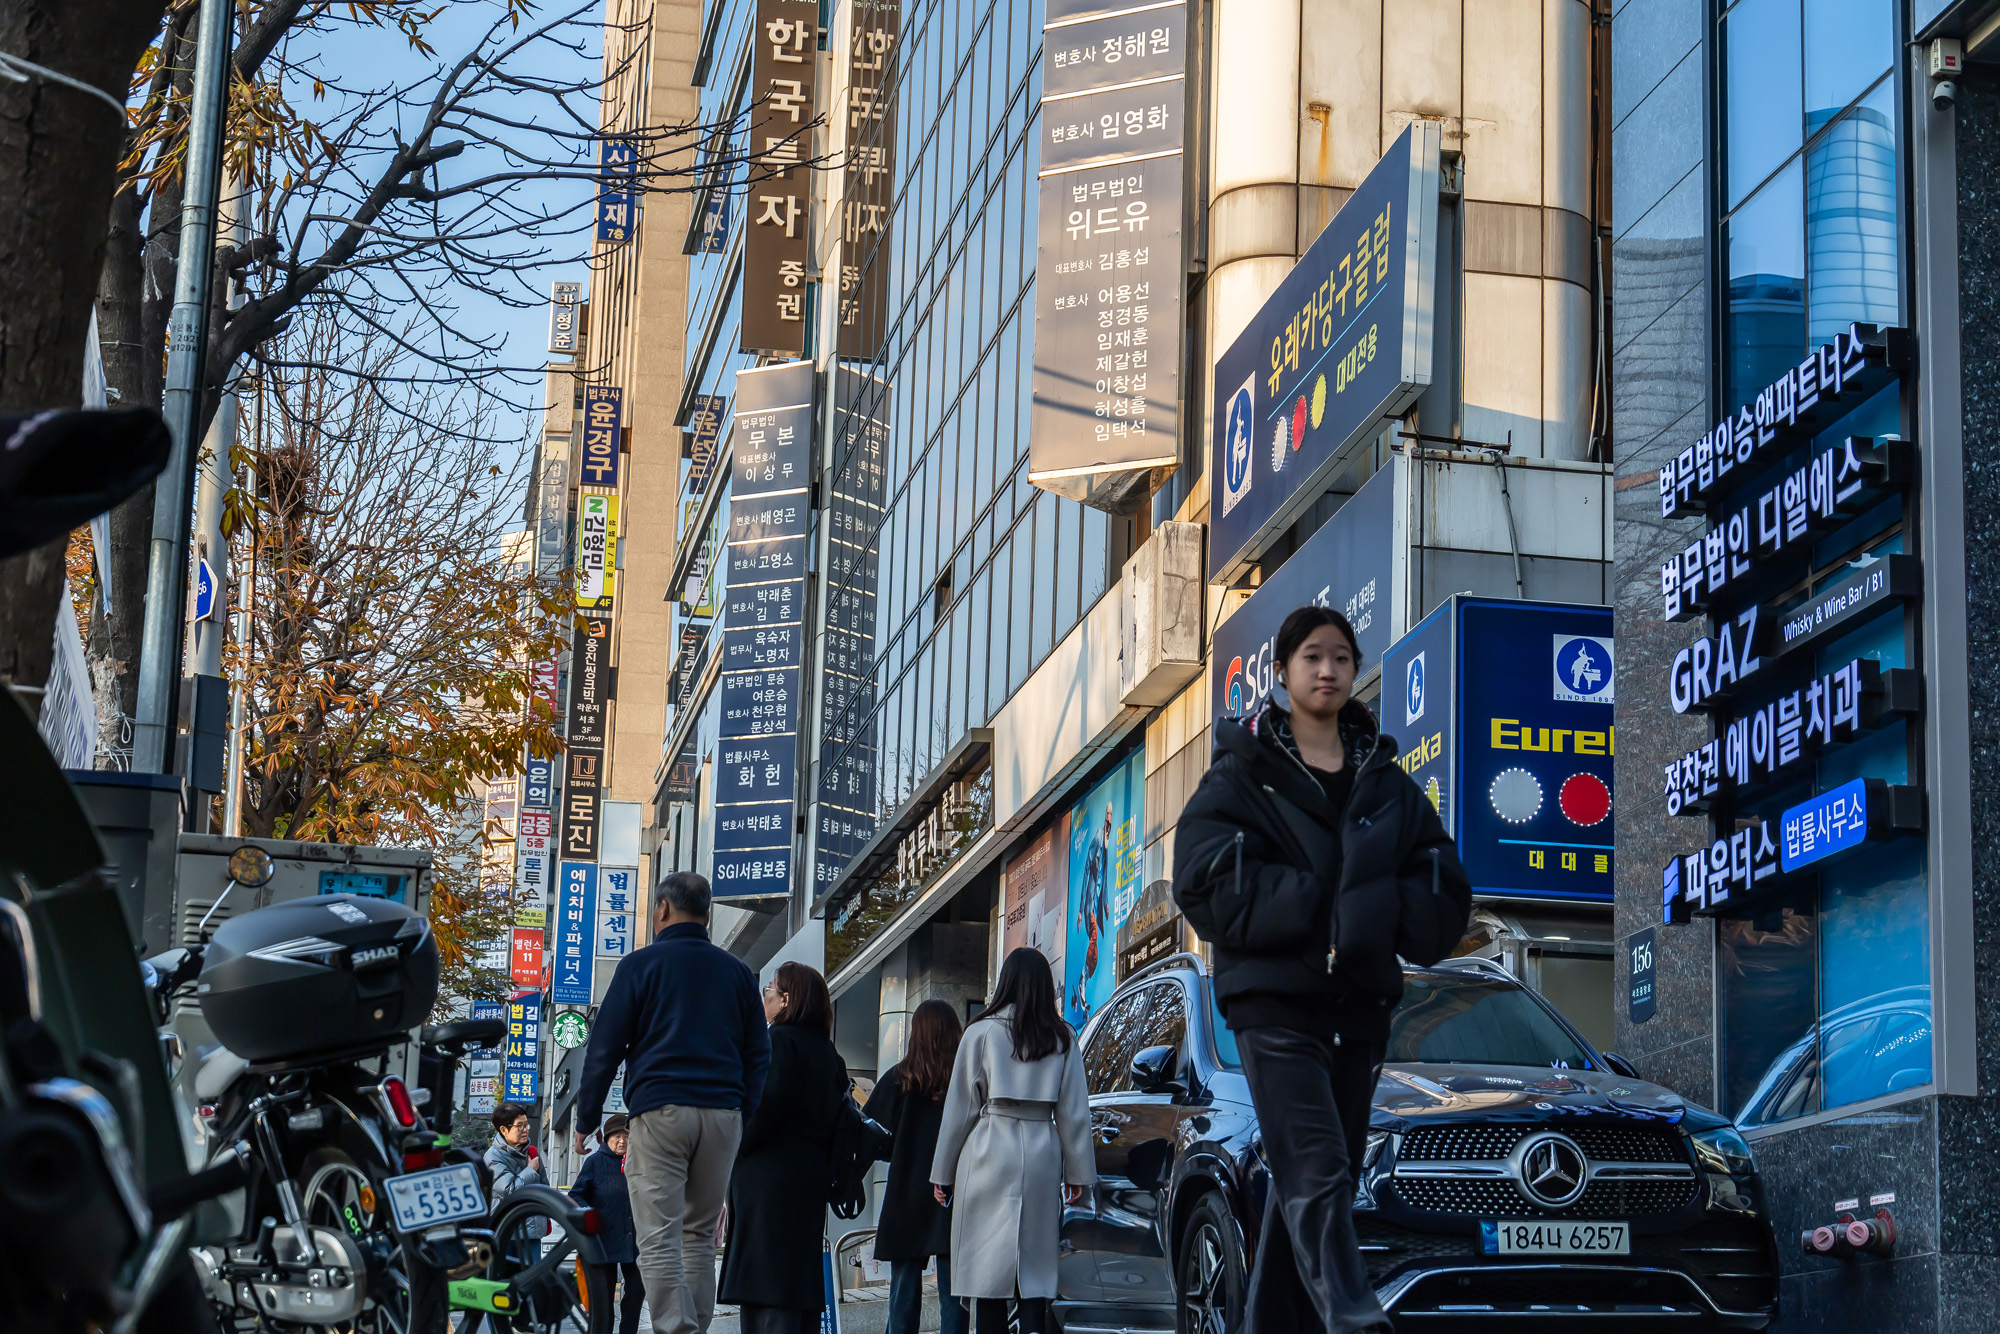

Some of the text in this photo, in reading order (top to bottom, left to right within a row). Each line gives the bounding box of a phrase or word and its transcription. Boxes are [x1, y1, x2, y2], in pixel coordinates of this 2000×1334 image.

[1054, 27, 1170, 69] 변호사 정해원
[756, 18, 809, 239] 한국투자
[1051, 104, 1169, 144] 변호사 임영화
[1073, 175, 1143, 203] 법무법인
[1066, 201, 1150, 241] 위드유
[607, 228, 625, 240] 7층
[1055, 247, 1149, 274] 대표변호사 김홍섭
[776, 261, 805, 322] 증권
[1054, 281, 1150, 310] 변호사 어용선
[1268, 201, 1391, 398] 유레카당구클럽
[1098, 304, 1149, 328] 정경동
[1097, 327, 1149, 351] 임재훈
[1095, 350, 1148, 372] 제갈헌
[1336, 323, 1377, 394] 대대전용
[1095, 372, 1147, 394] 이창섭
[588, 388, 620, 402] 법무사
[1095, 395, 1147, 417] 허성흠
[741, 415, 776, 429] 법무법인
[1095, 418, 1146, 442] 임택석
[586, 402, 617, 482] 윤경구
[748, 426, 795, 449] 무본
[739, 451, 776, 465] 대표변호사
[745, 463, 794, 482] 이상무
[736, 507, 796, 526] 변호사 배영곤
[1662, 435, 1862, 622] 법무법인 디엘에스
[734, 552, 793, 570] 변호사 고영소
[599, 598, 611, 608] 4F
[757, 587, 792, 604] 박래춘
[1784, 613, 1814, 642] Whisky
[1815, 606, 1823, 625] &
[1824, 596, 1846, 619] Wine
[1848, 585, 1863, 606] Bar
[1872, 569, 1883, 592] B1
[732, 602, 791, 622] 변호사 김준
[730, 644, 790, 663] 법무사 노명자
[1670, 605, 1760, 714] GRAZ
[583, 638, 598, 704] 웅진씽크빅
[727, 673, 785, 689] 법무법인 문승
[752, 688, 788, 703] 여운승
[1556, 693, 1587, 702] SINDS
[577, 703, 600, 713] 라운지
[727, 703, 787, 719] 변호사 천우현
[579, 715, 595, 724] 서초
[581, 726, 592, 734] 3F
[750, 718, 787, 734] 문상석
[725, 749, 770, 764] 법률사무소
[570, 780, 597, 788] 법률사무소
[738, 763, 781, 789] 화헌
[1664, 738, 1719, 817] 정찬권
[522, 815, 551, 836] 공증
[568, 795, 593, 853] 로진
[722, 815, 782, 832] 변호사 박태호
[526, 838, 545, 849] 5층
[1116, 814, 1136, 858] 연금이
[898, 807, 938, 890] 한국투자
[1685, 792, 1864, 910] 파운더스 법률사무소
[717, 861, 787, 881] SGI서울보증
[1114, 843, 1142, 891] 자신감을
[1113, 884, 1135, 927] 만든다
[351, 946, 399, 964] SHAD
[514, 939, 541, 950] 밸런스
[523, 953, 533, 962] 11
[1631, 940, 1652, 975] 156
[508, 1004, 524, 1057] 법무사
[524, 1006, 538, 1057] 김일동
[510, 1073, 533, 1085] 밀알
[509, 1085, 532, 1097] 녹취
[419, 1184, 477, 1218] 5355
[1502, 1226, 1624, 1249] 184나 6257
